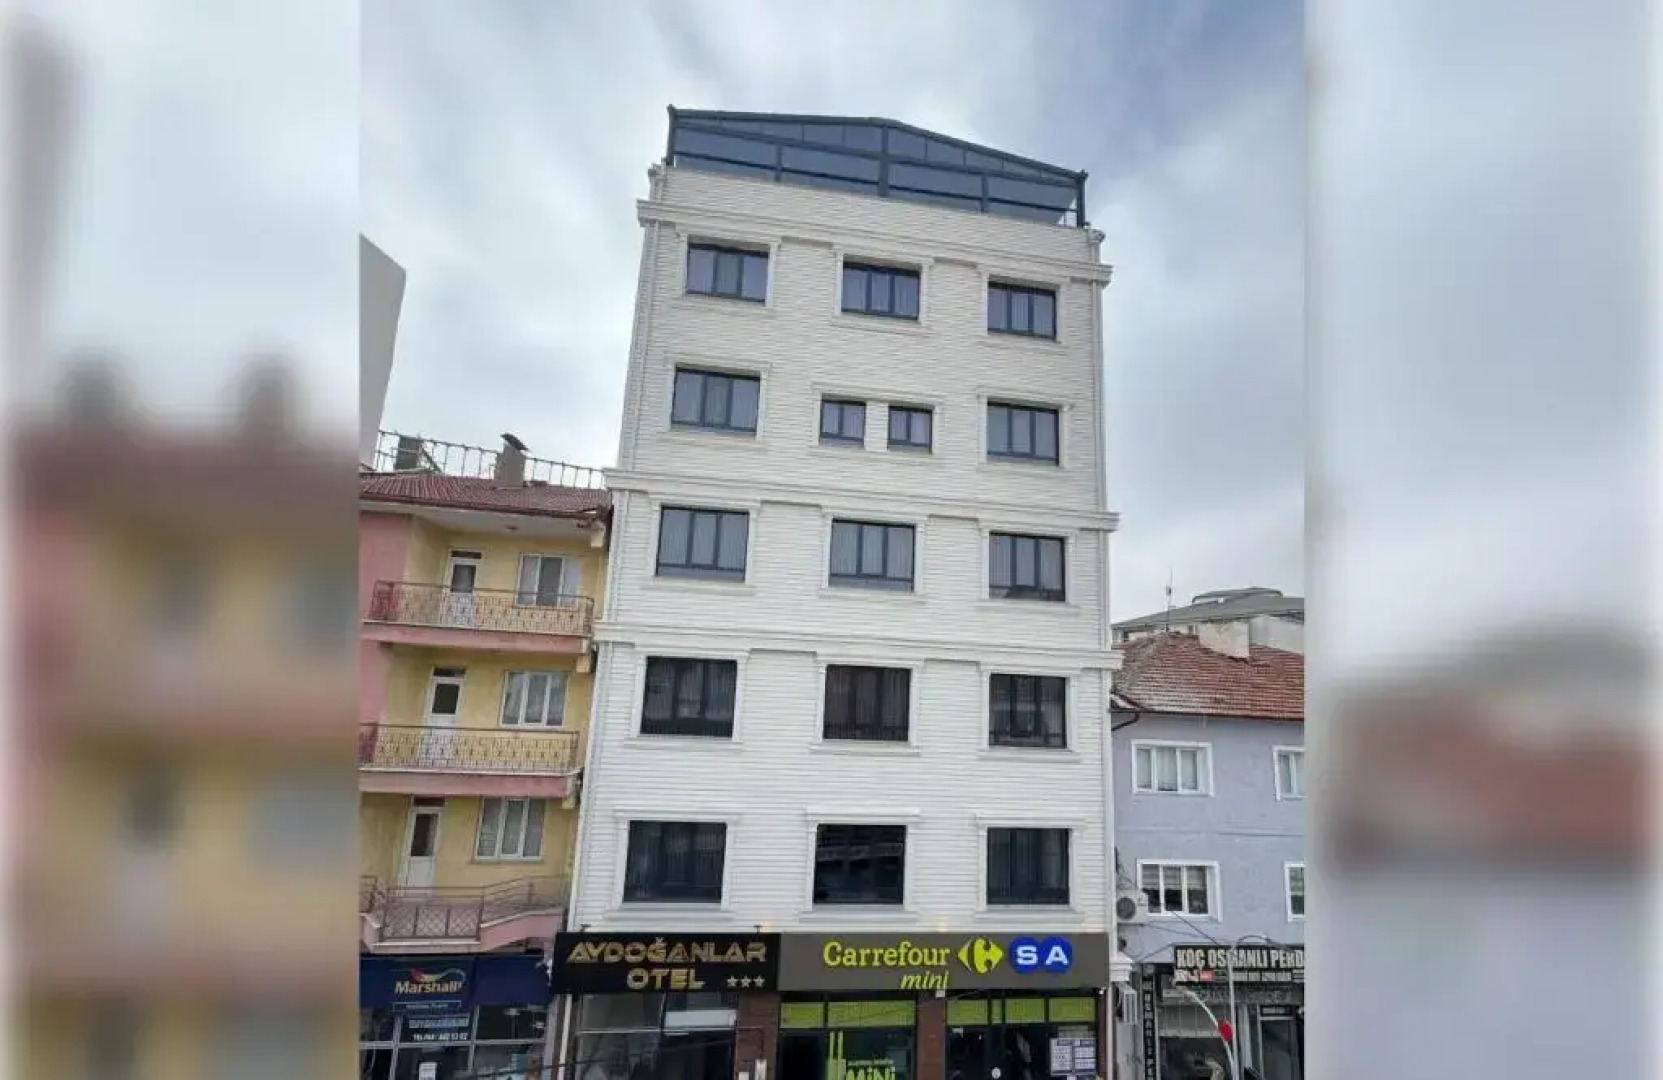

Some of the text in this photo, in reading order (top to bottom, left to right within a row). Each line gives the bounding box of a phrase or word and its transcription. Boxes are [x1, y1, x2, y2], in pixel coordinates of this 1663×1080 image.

[567, 937, 767, 963] AYDOĞANLAR
[822, 941, 1070, 967] Carrefour SA
[1177, 949, 1206, 971] KOÇ
[394, 980, 462, 995] Marshall
[626, 967, 706, 990] OTEL
[900, 970, 949, 989] mini
